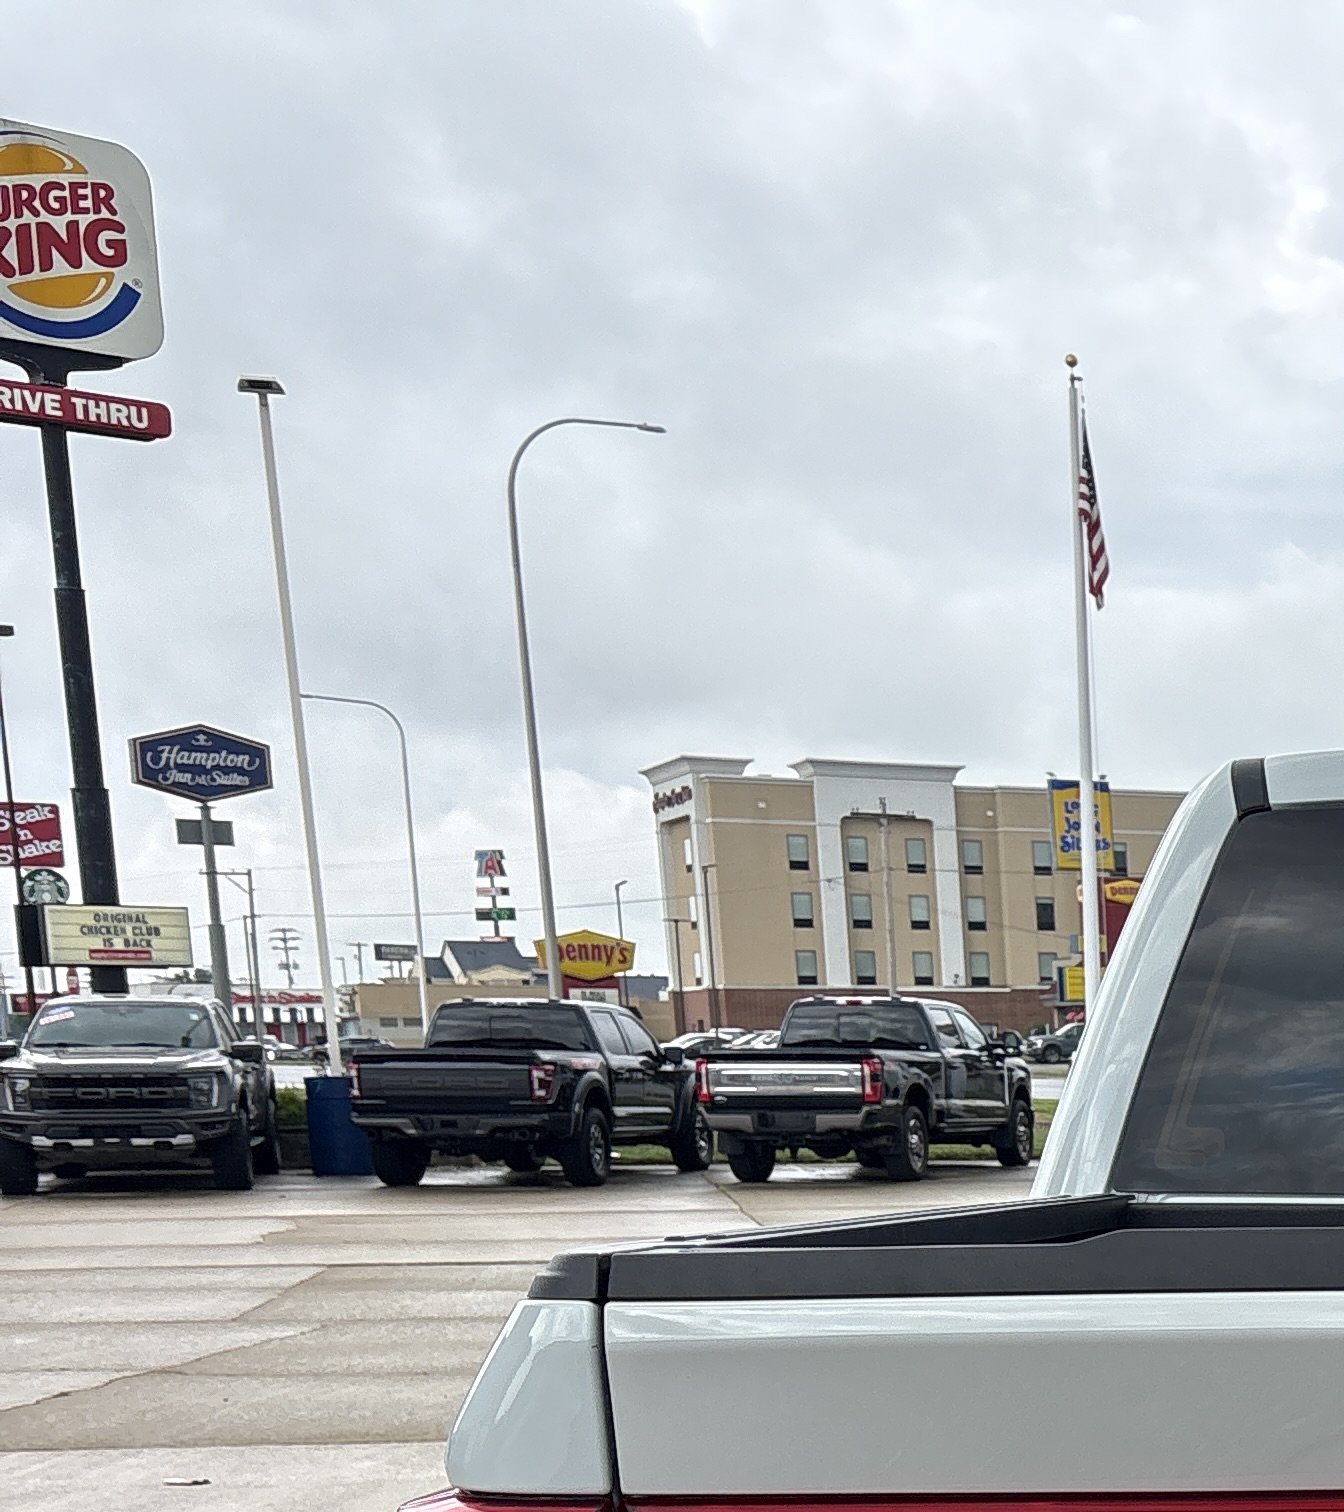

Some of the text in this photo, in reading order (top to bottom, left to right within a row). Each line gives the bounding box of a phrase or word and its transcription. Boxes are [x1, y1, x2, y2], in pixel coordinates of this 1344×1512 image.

[70, 396, 149, 429] THRU
[146, 745, 259, 770] Hampton
[159, 769, 196, 785] Inn
[93, 912, 149, 924] ORIGINAL
[80, 925, 161, 937] CHICKEN CLUB
[103, 937, 154, 948] IS BACK
[43, 1087, 175, 1099] FORD
